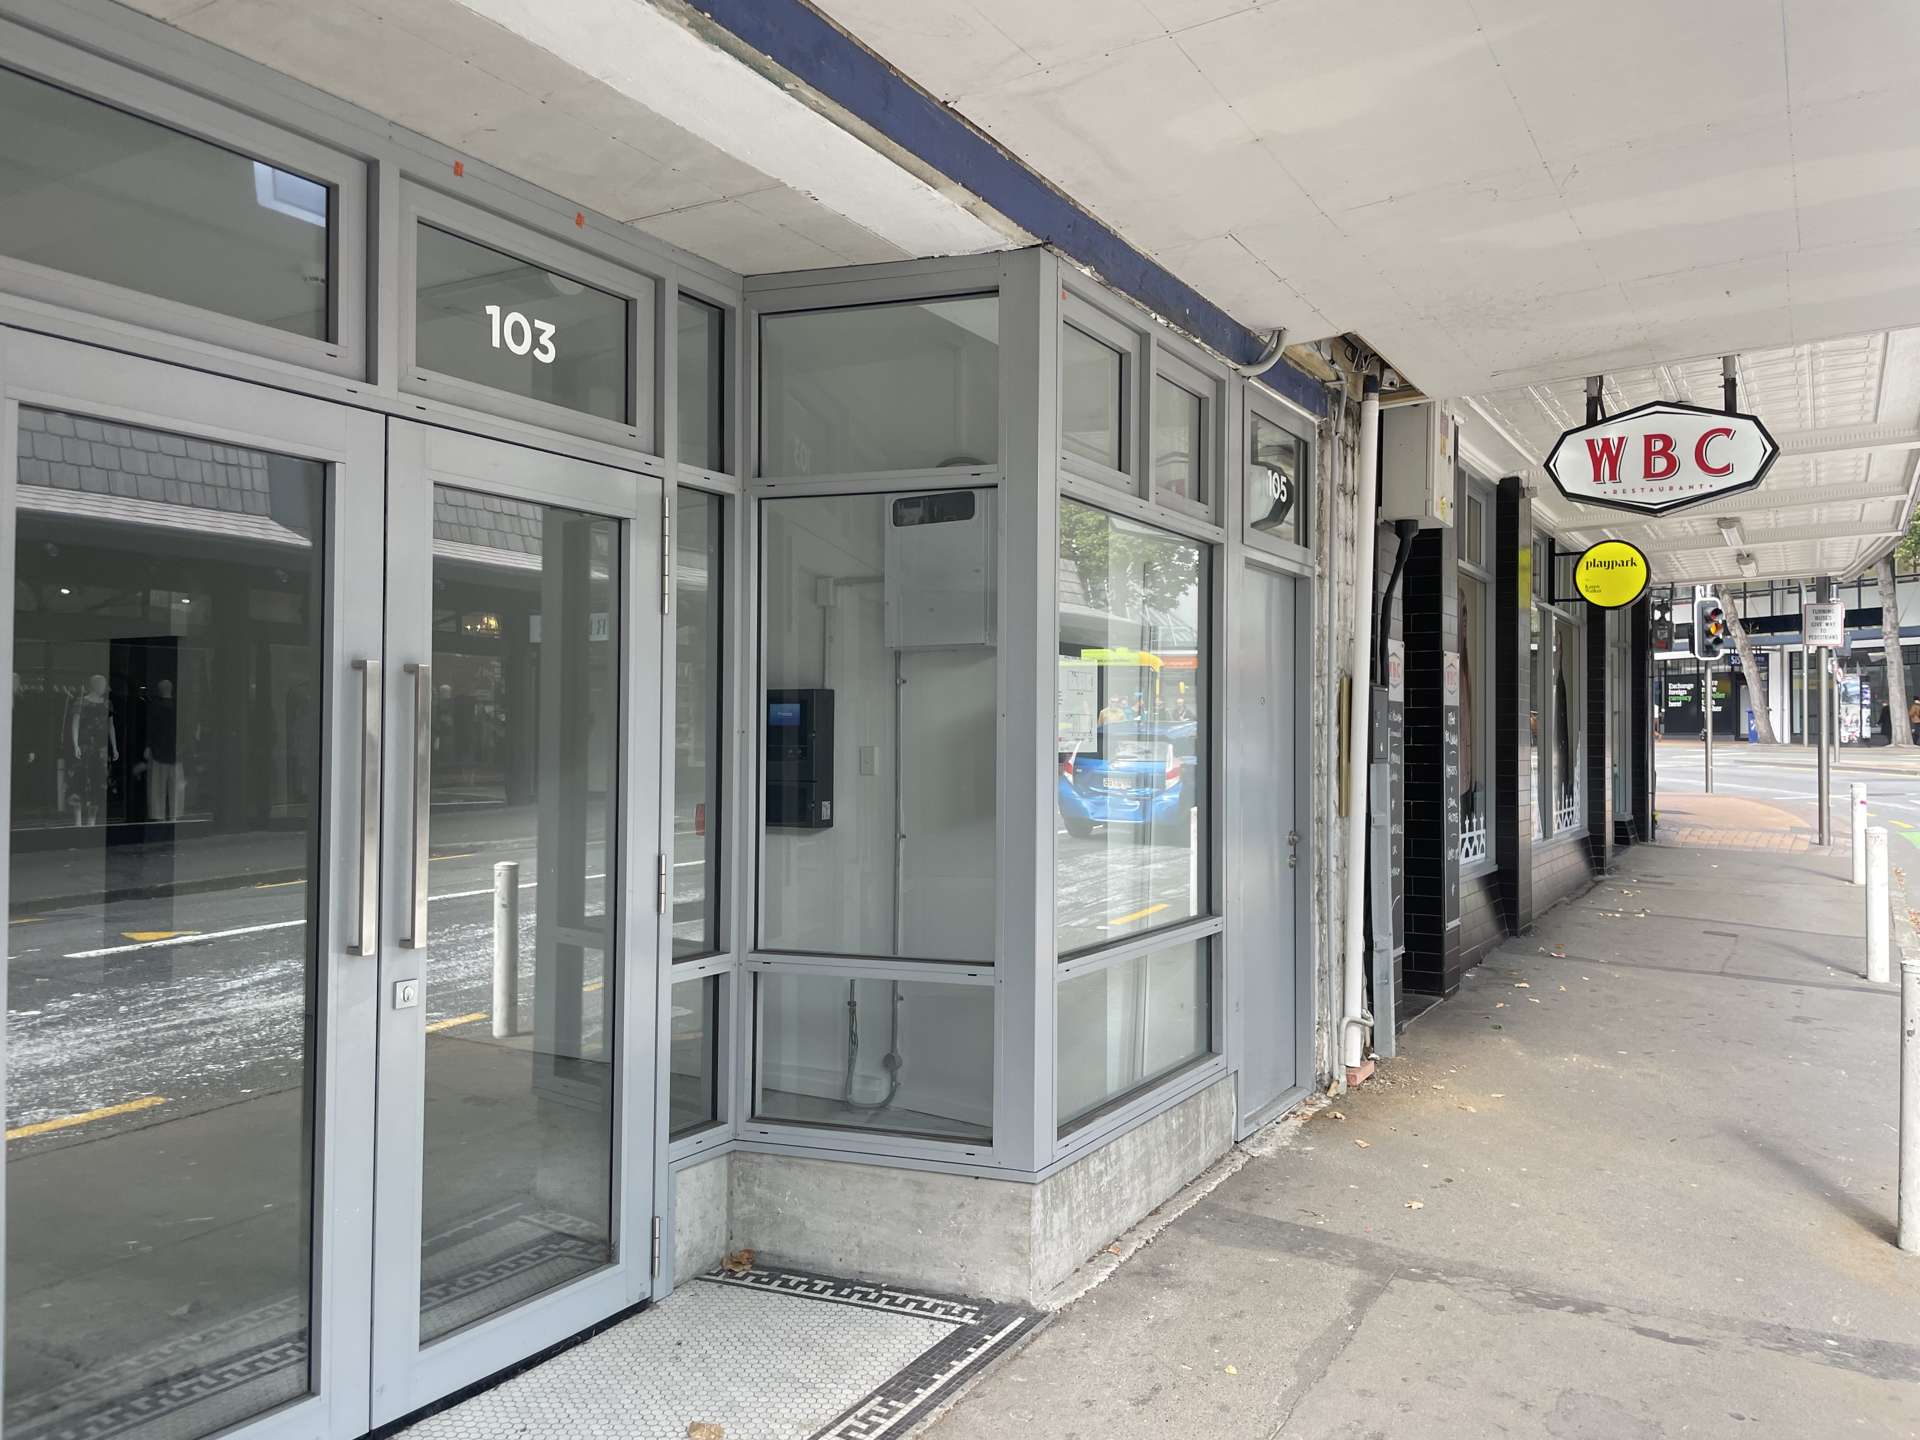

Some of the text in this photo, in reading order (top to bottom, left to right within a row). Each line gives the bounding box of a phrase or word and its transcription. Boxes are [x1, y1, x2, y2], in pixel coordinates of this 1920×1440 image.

[485, 305, 556, 364] 103
[1585, 427, 1736, 485] WBC
[1267, 469, 1288, 503] 105
[1612, 483, 1704, 495] RESTAURANT
[1585, 557, 1637, 571] playpark
[1668, 682, 1694, 690] Exchange
